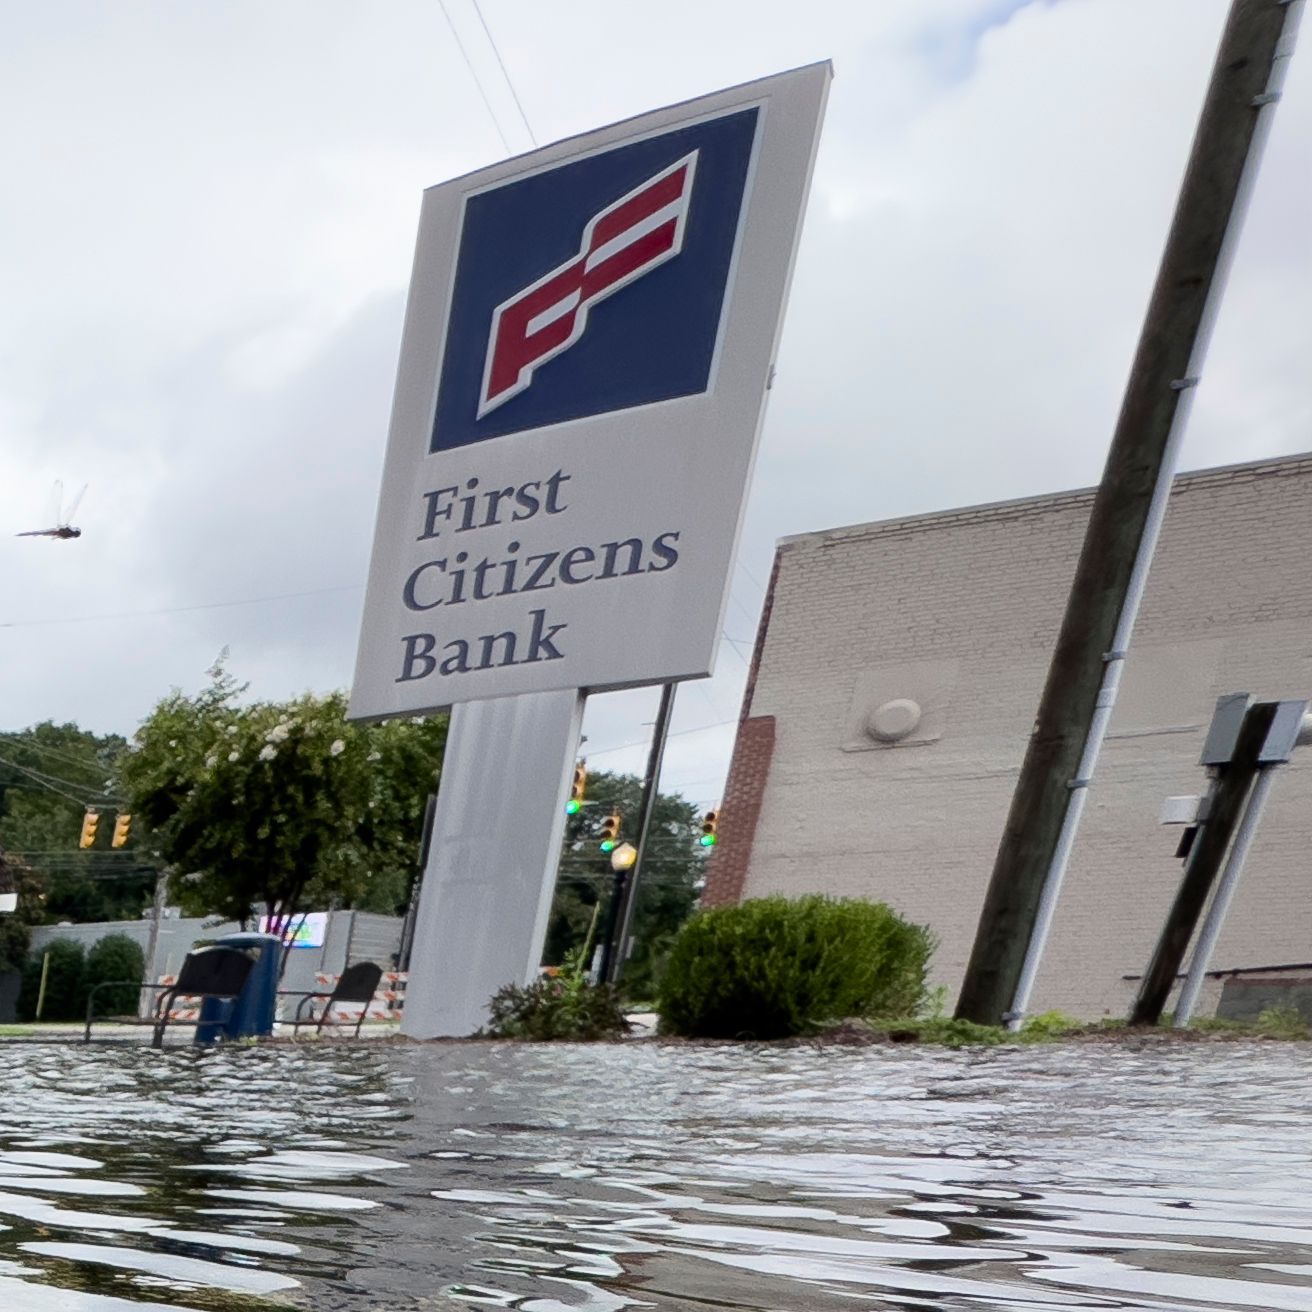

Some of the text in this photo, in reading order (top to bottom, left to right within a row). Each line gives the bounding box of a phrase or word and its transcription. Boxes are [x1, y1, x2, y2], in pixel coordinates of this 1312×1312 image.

[416, 468, 572, 542] First
[402, 531, 681, 612] Citizens
[394, 608, 568, 684] Bank
